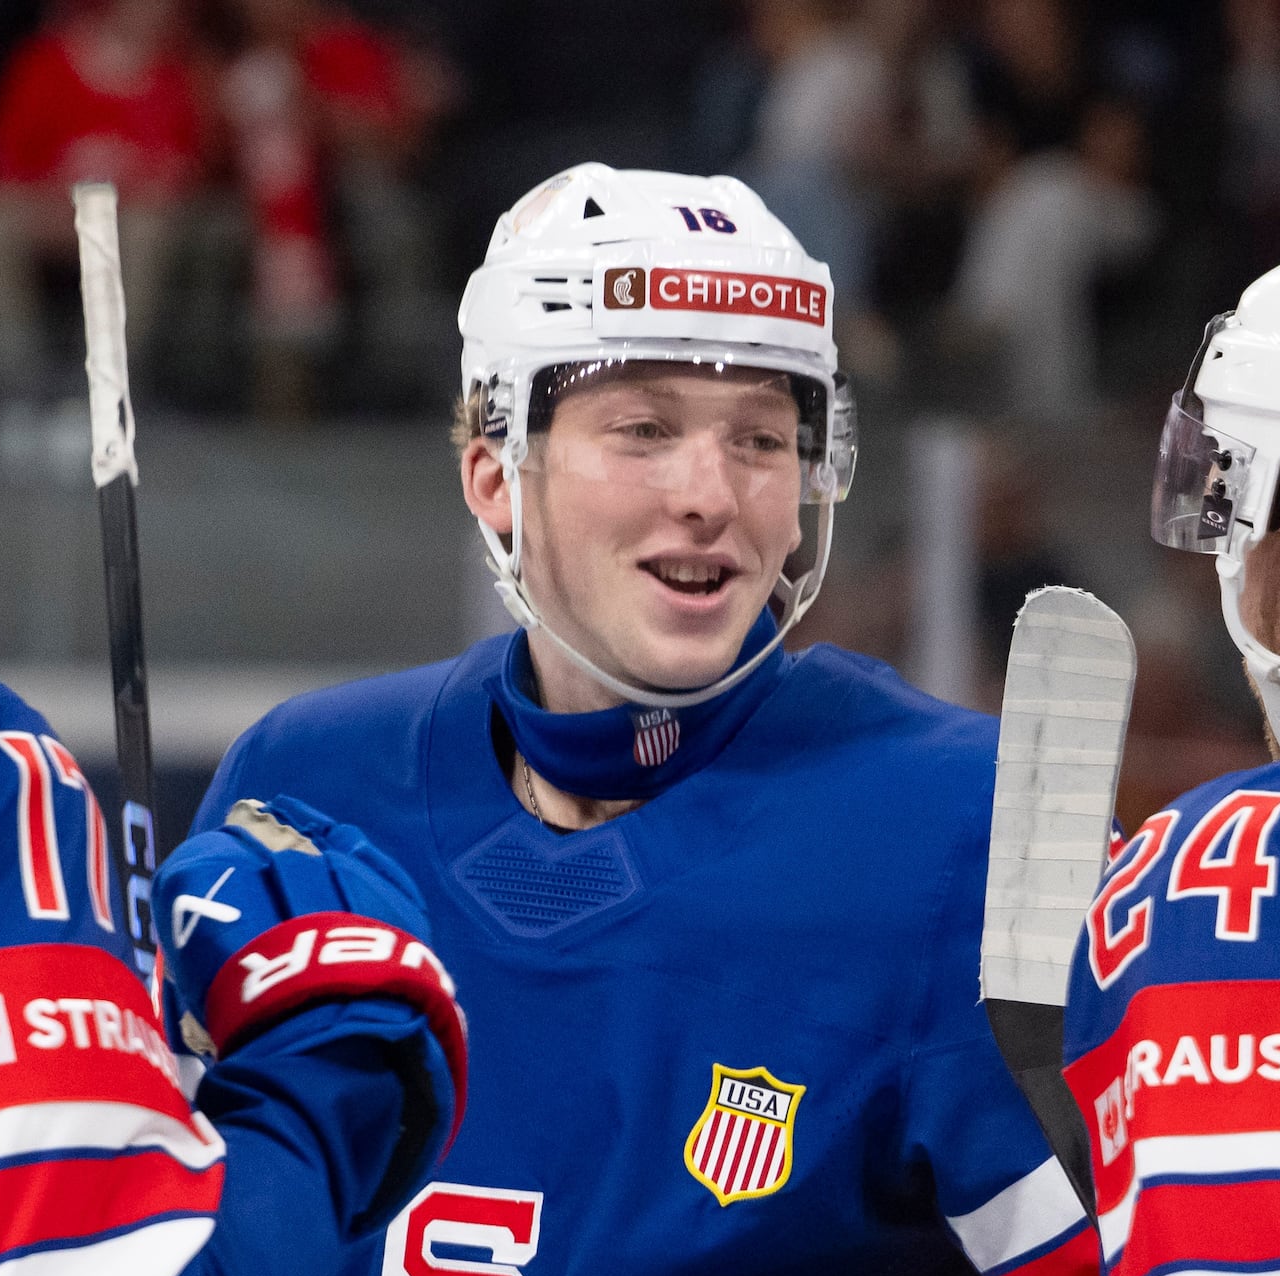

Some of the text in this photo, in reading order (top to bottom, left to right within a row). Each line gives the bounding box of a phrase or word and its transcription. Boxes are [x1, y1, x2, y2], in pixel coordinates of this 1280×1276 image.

[675, 206, 737, 234] 16
[658, 273, 821, 318] CHIPOTLE
[639, 707, 672, 729] USA
[727, 1082, 778, 1117] USA
